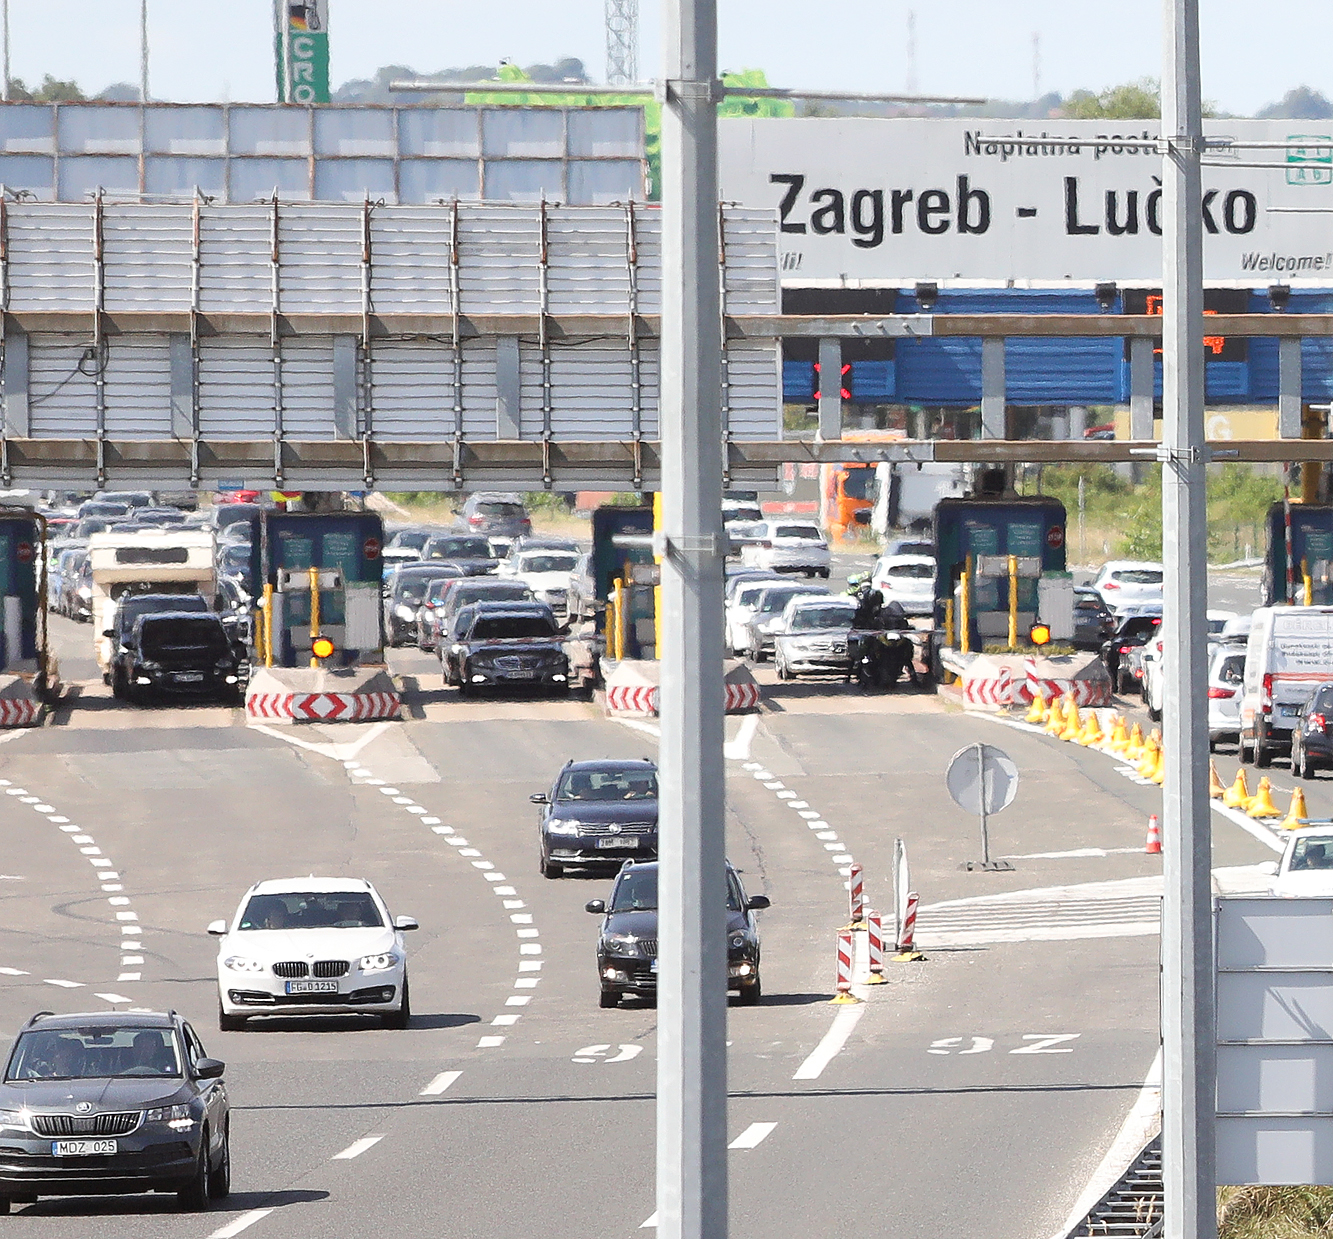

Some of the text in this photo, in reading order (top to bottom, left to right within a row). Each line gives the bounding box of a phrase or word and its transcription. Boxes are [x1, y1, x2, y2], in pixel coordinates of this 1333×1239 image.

[769, 173, 991, 249] Zagreb
[1241, 252, 1333, 272] Welcome!
[59, 1140, 115, 1154] MDZ 025
